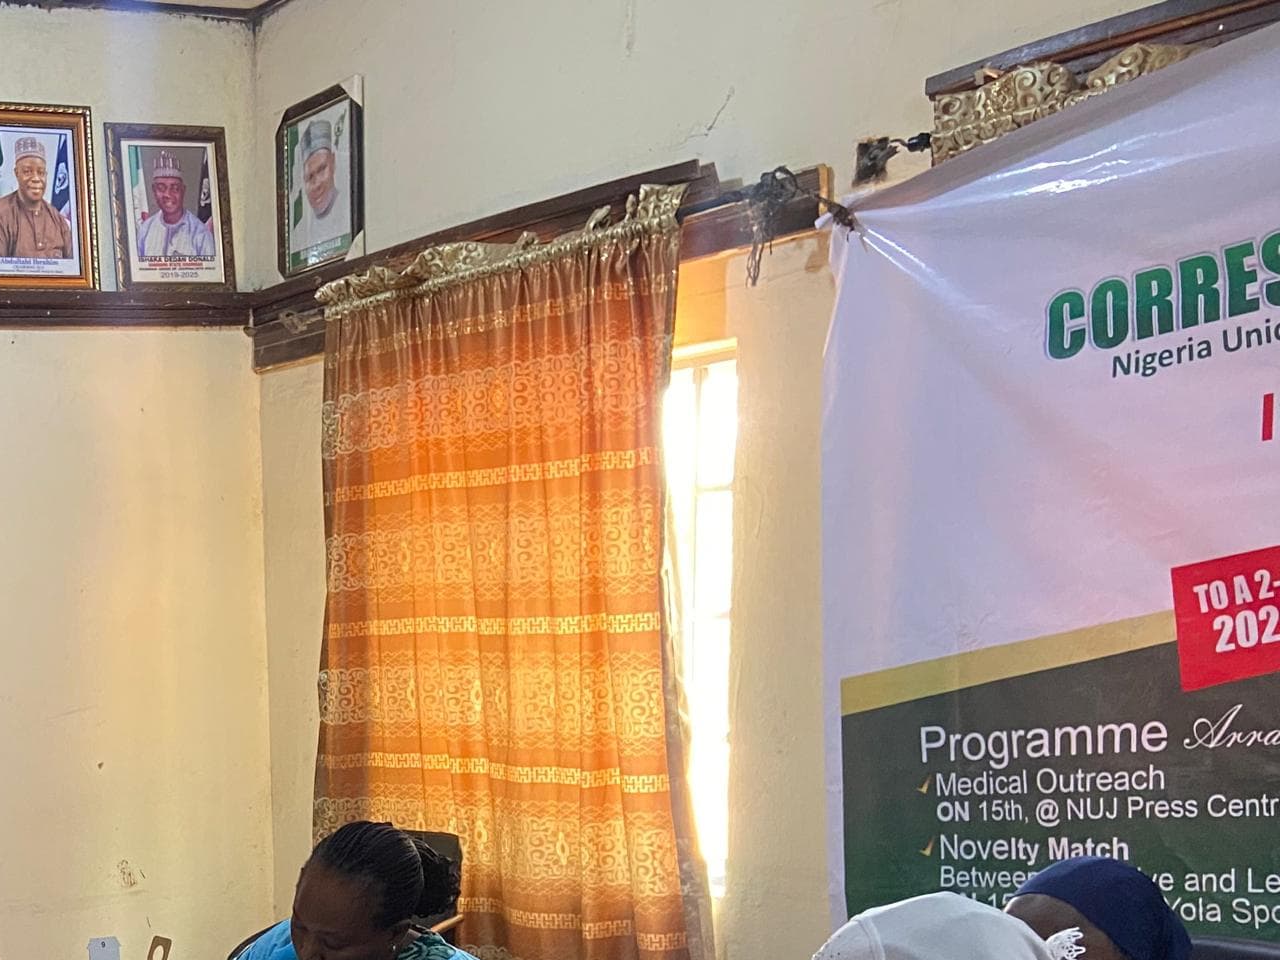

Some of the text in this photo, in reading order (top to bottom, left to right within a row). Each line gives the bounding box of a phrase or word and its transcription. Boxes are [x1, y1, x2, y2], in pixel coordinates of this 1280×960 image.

[1112, 337, 1212, 379] Nigeria
[1193, 580, 1229, 614] TO
[1233, 574, 1254, 606] A
[1212, 605, 1280, 653] 202
[920, 703, 1280, 770] Programme Arra
[936, 764, 1165, 797] Medical Outreach
[936, 793, 1280, 828] ON 15th, @ NUJ Press Centr
[940, 833, 1130, 866] Novelty Match
[1184, 867, 1236, 893] and
[1163, 896, 1221, 922] Yola
